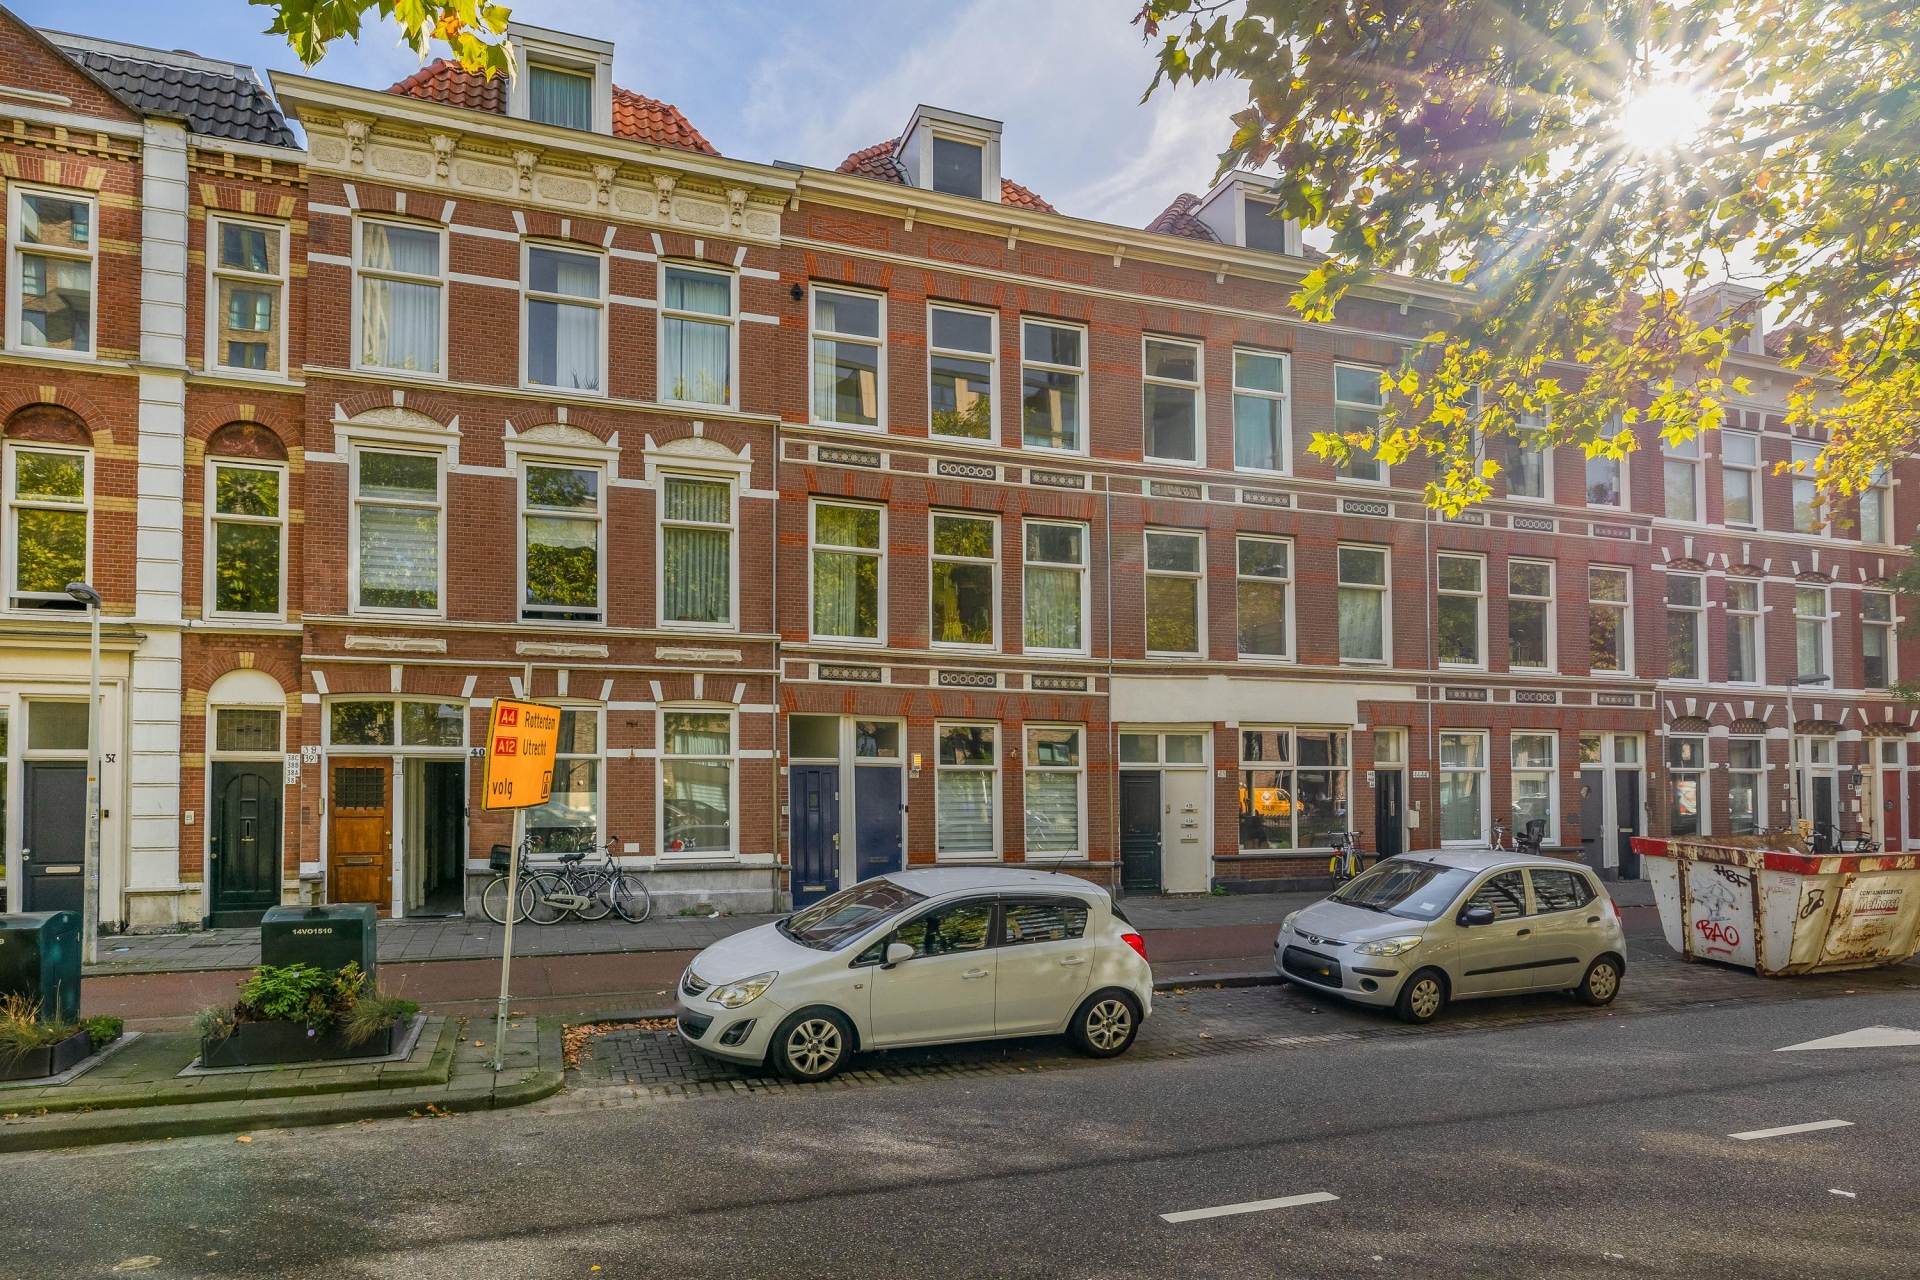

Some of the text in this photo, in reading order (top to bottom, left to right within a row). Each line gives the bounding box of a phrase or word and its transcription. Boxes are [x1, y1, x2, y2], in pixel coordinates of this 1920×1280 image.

[501, 709, 556, 730] A4 Rotterdam
[471, 748, 486, 756] 40
[497, 739, 547, 756] A12 Utrecht
[105, 754, 116, 763] 37
[492, 778, 513, 800] volg
[1856, 896, 1900, 911] Methorst
